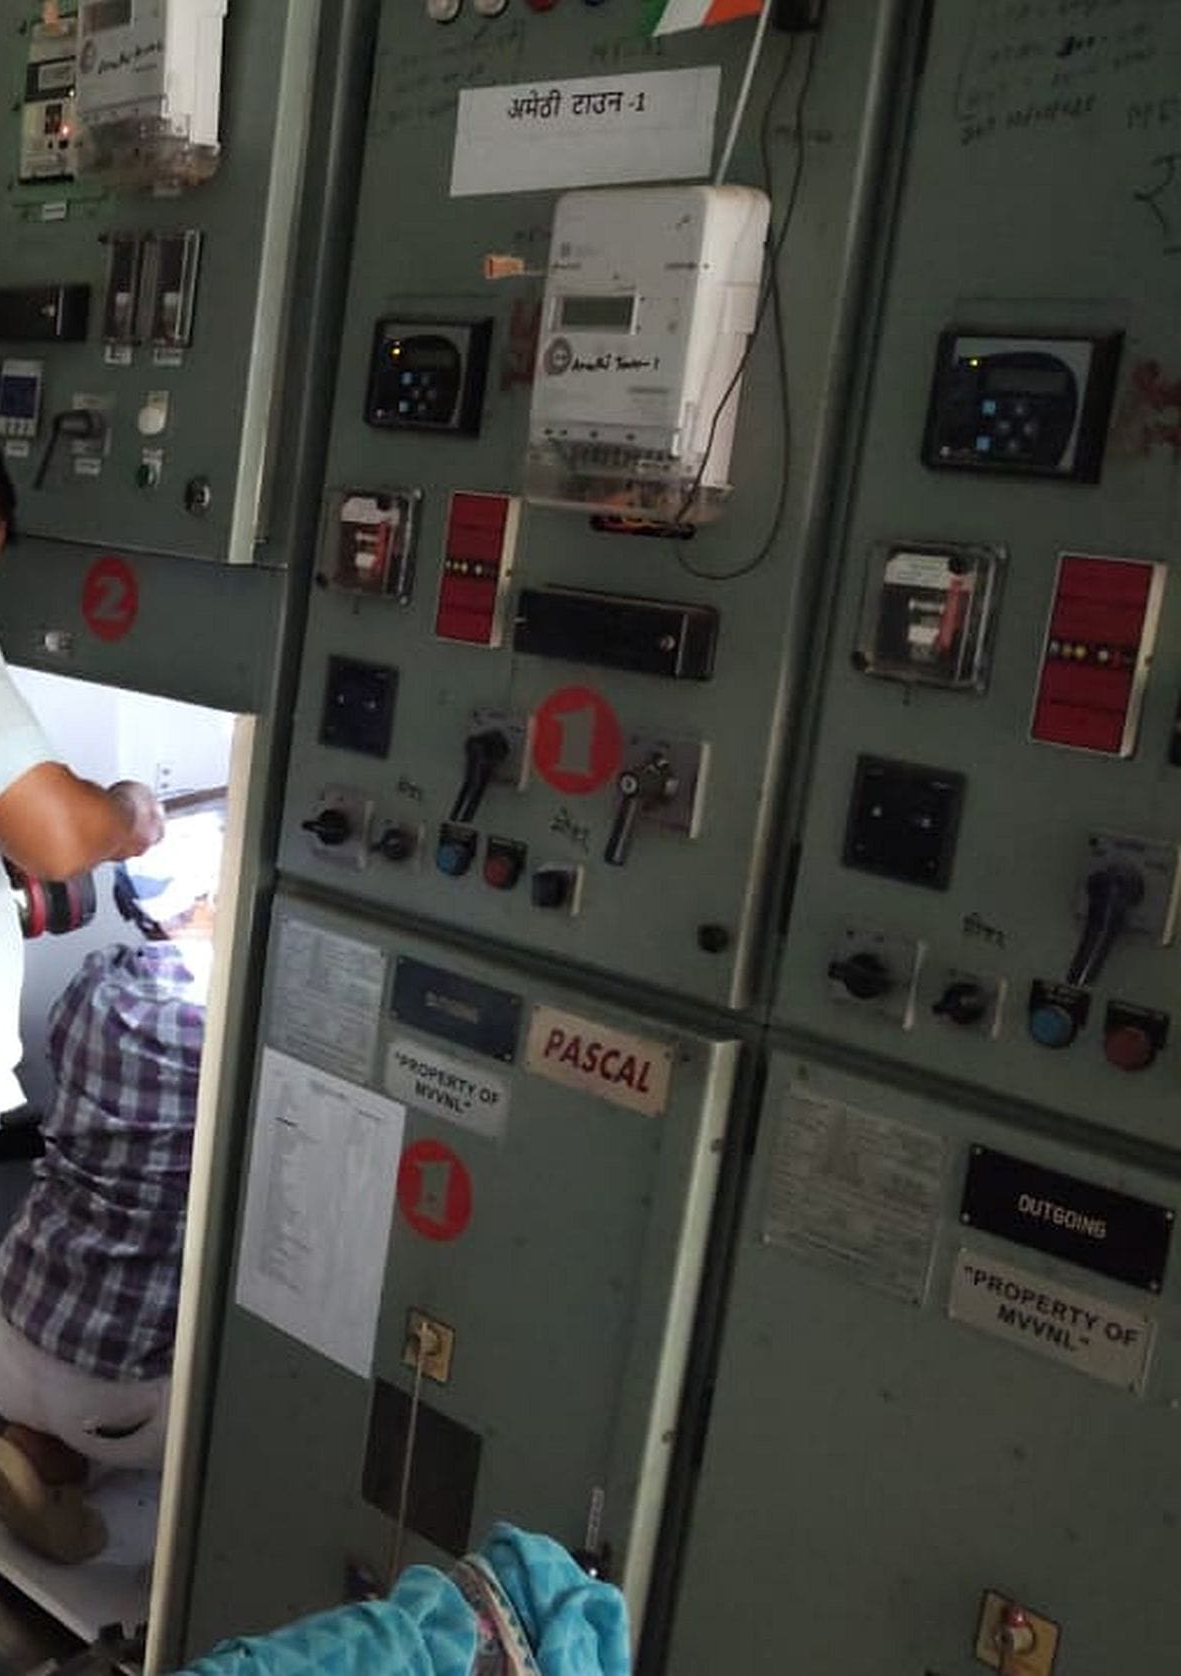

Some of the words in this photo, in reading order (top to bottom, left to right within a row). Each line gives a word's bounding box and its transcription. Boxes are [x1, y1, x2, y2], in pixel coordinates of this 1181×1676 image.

[508, 89, 561, 118] अमेठी
[572, 92, 624, 115] टाउन
[93, 576, 128, 621] 2
[554, 706, 596, 776] 1
[543, 1028, 652, 1094] PASCAL
[479, 1087, 500, 1104] OF
[413, 1160, 452, 1224] 1
[1018, 1193, 1108, 1240] OUTGOING
[963, 1265, 1099, 1331] "PROPERTY
[1105, 1322, 1139, 1346] OF
[997, 1302, 1091, 1352] MVVNL"
